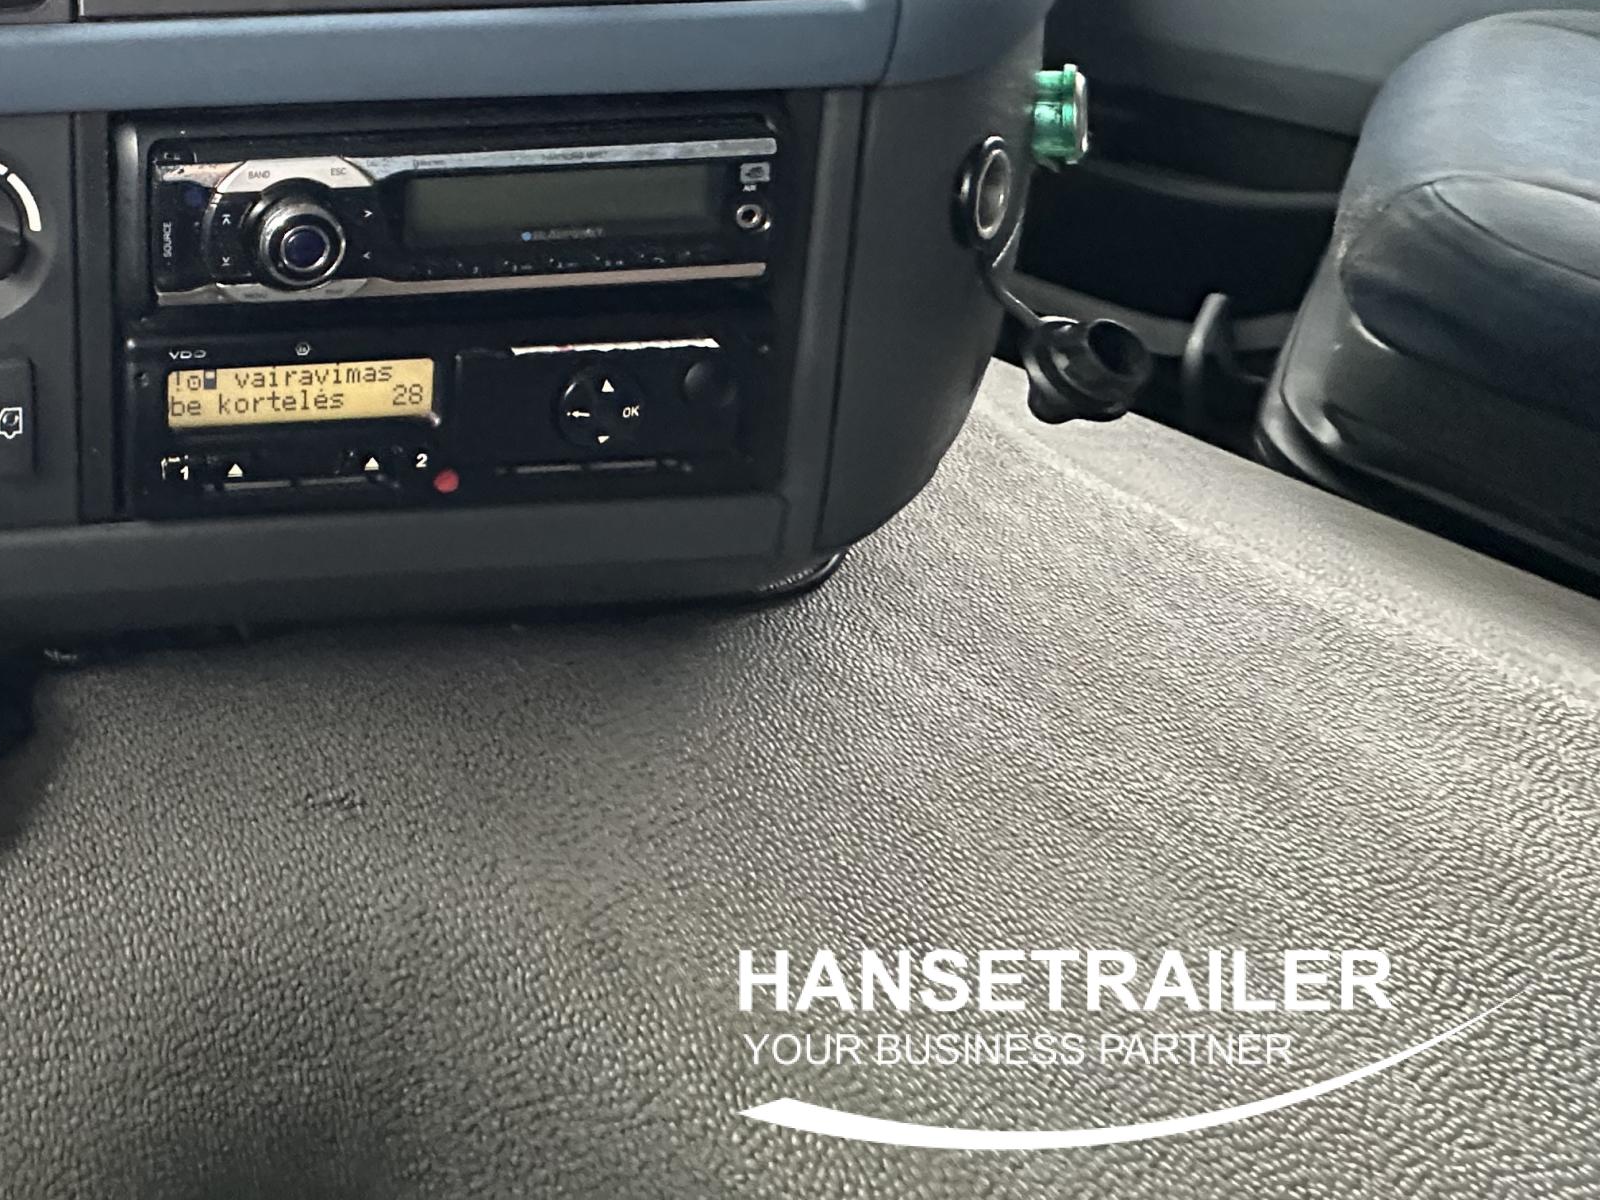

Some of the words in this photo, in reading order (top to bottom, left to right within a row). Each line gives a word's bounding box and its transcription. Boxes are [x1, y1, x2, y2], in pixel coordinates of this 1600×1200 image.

[248, 170, 270, 179] BAND
[331, 167, 347, 177] ESC
[163, 221, 172, 258] SOURCE
[234, 363, 392, 389] vairavimas
[171, 396, 201, 417] be
[392, 384, 423, 406] 28
[622, 405, 640, 419] OK
[416, 453, 428, 468] 2
[180, 466, 190, 481] 1
